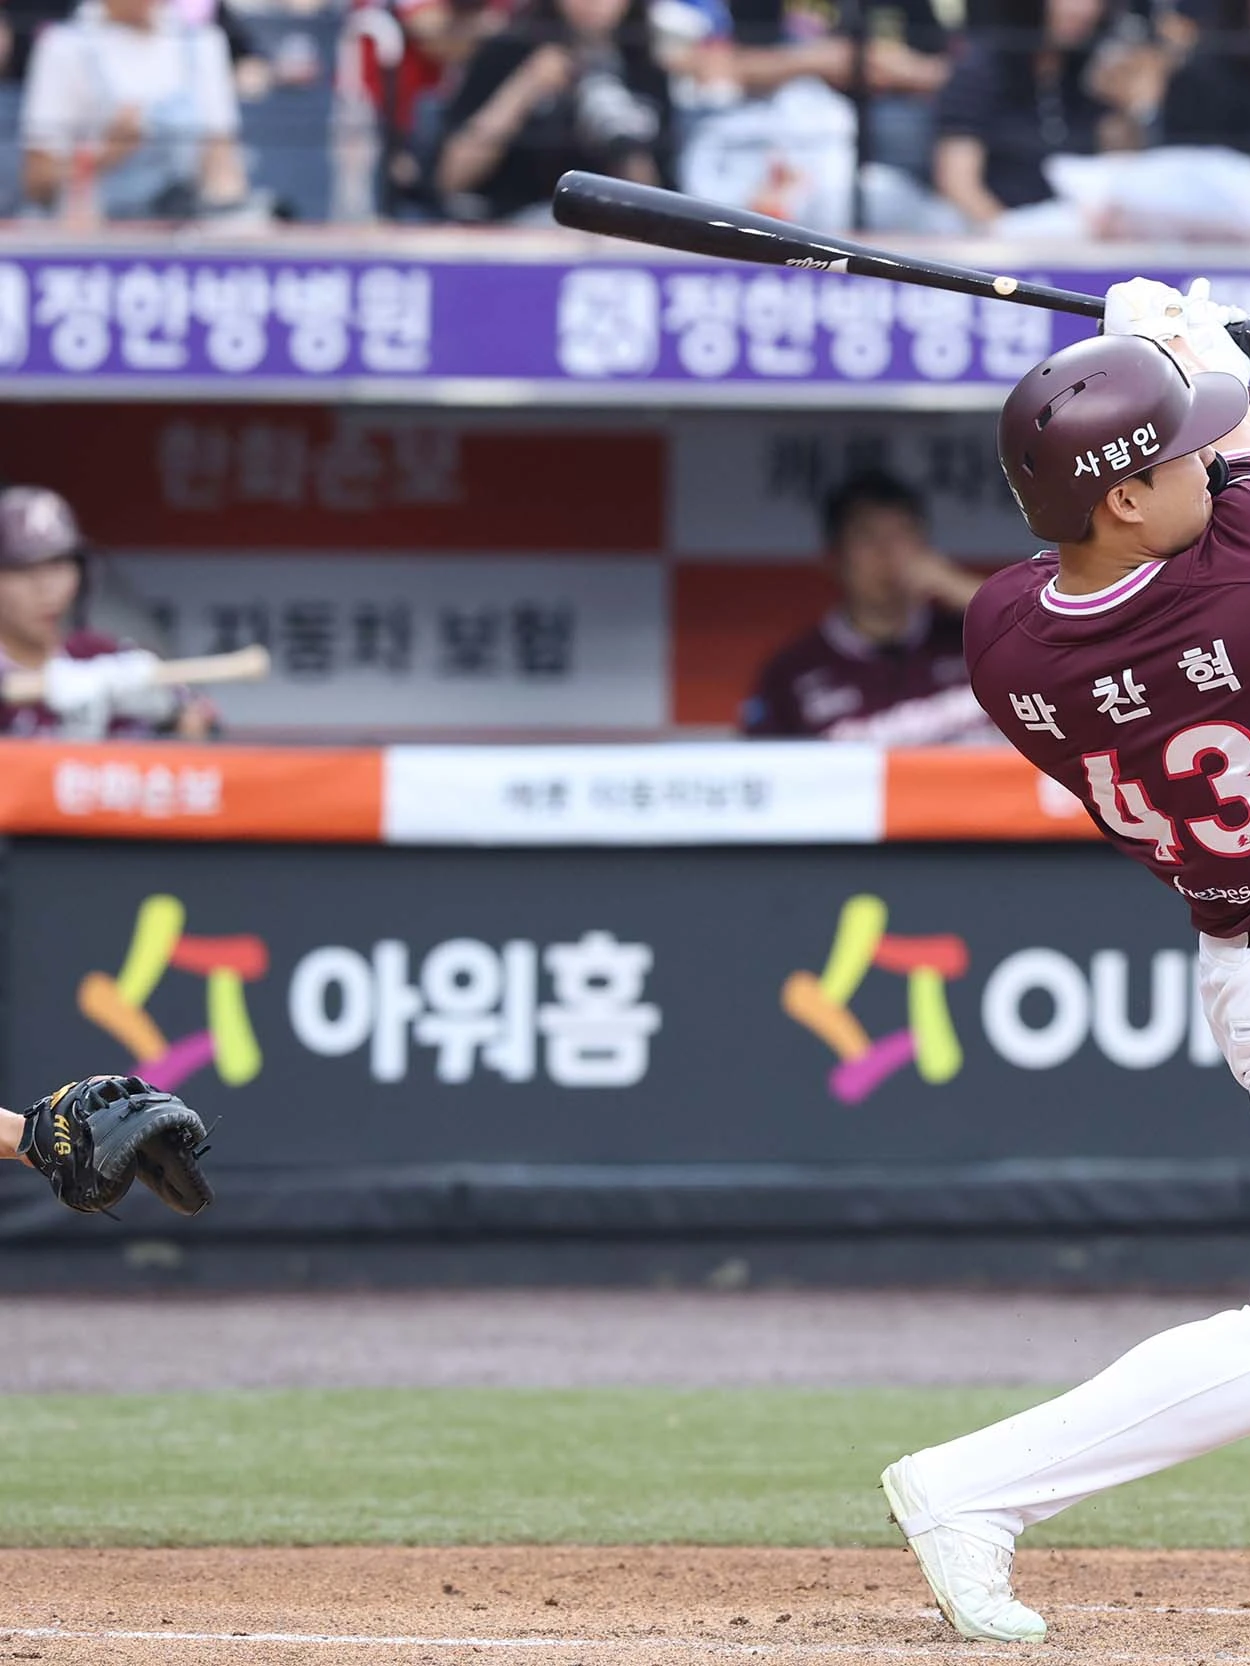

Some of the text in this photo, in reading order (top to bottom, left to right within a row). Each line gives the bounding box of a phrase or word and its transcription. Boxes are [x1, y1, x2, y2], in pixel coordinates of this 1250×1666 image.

[36, 262, 433, 372] 정한방병원
[1074, 422, 1160, 477] 사람인
[288, 930, 662, 1087] 아워홈
